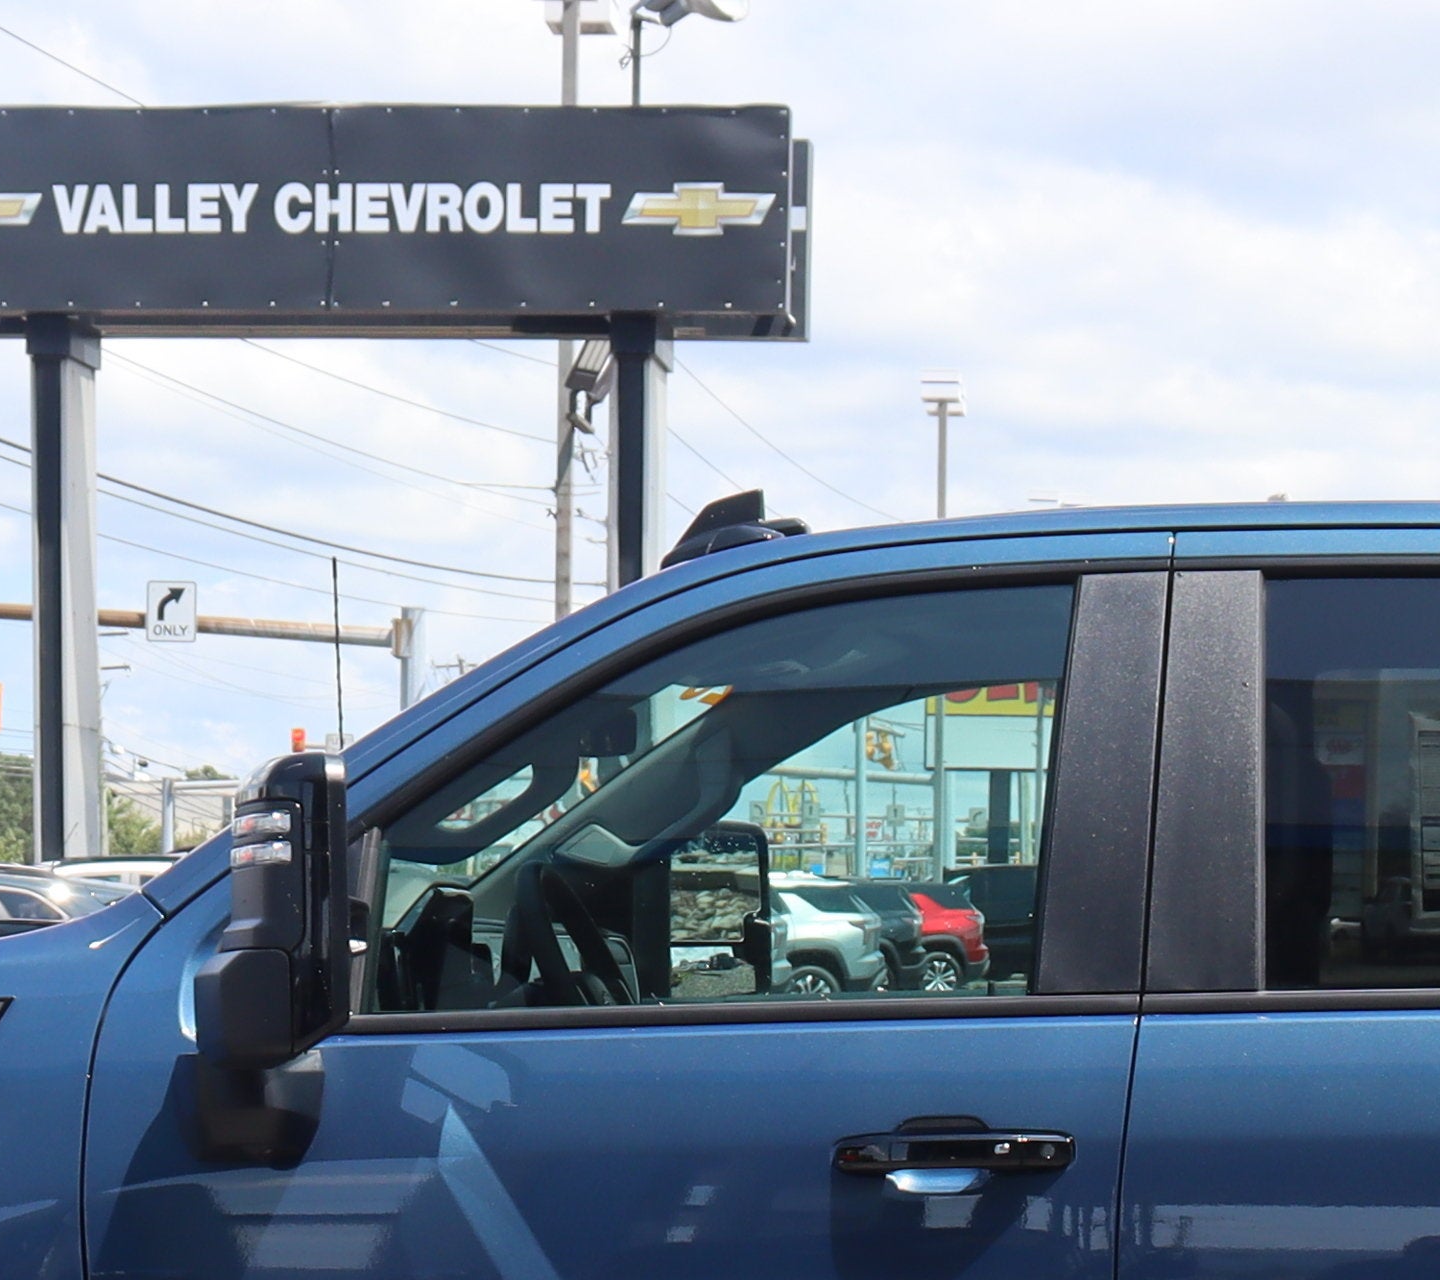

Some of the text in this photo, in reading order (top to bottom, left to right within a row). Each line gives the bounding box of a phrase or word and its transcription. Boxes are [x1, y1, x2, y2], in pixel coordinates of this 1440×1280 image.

[53, 181, 612, 235] VALLEY CHEVROLET
[153, 624, 188, 636] ONLY
